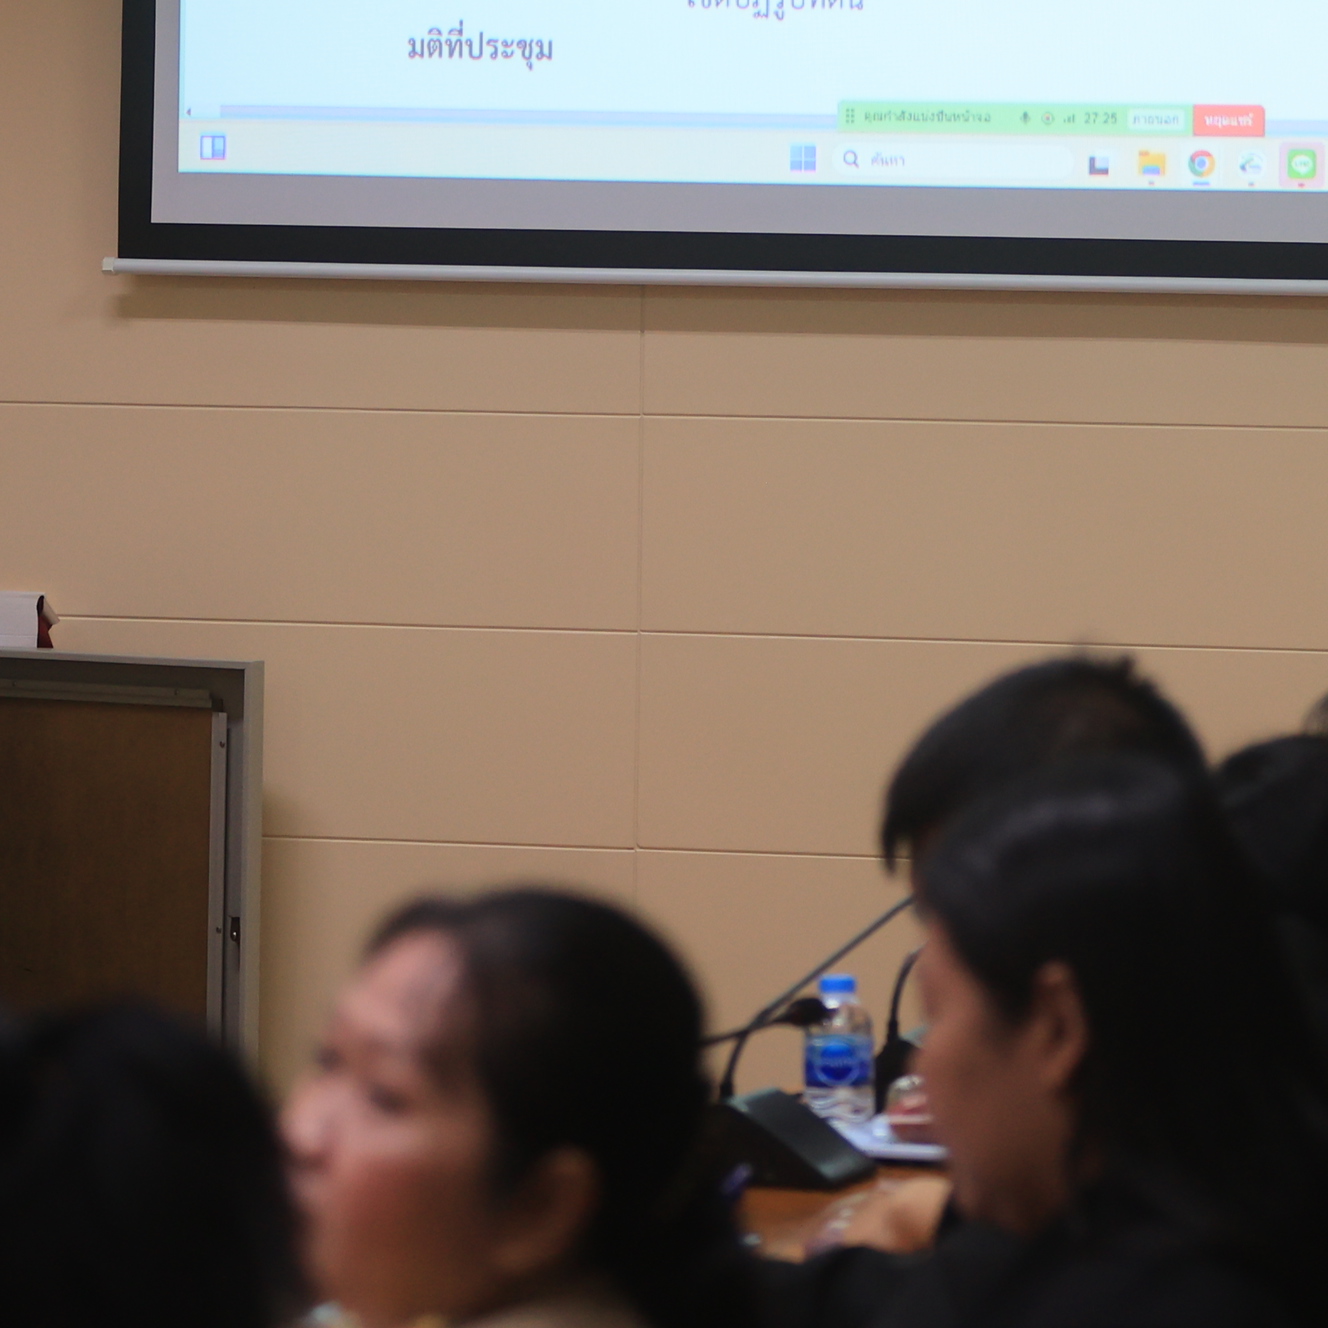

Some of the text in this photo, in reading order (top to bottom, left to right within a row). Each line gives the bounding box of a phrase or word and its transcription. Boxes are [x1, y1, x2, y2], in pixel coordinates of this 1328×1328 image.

[407, 19, 554, 72] มติที่ประชุม
